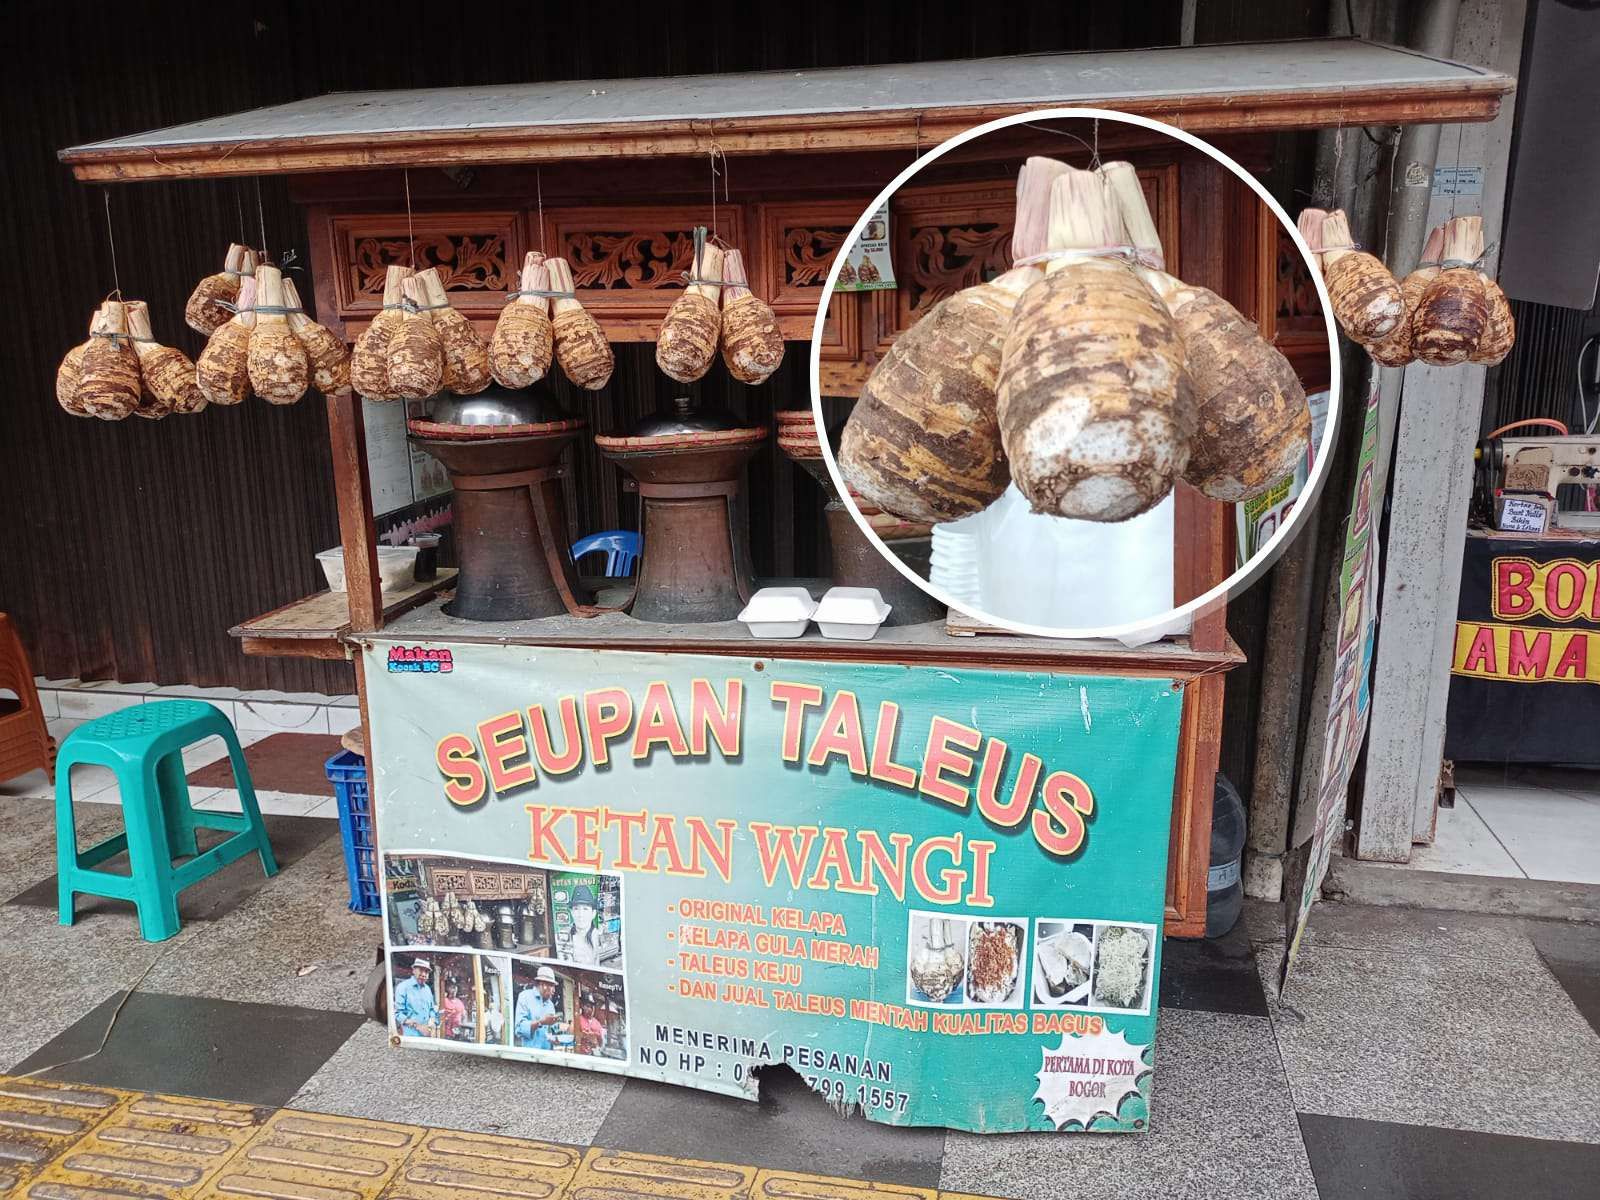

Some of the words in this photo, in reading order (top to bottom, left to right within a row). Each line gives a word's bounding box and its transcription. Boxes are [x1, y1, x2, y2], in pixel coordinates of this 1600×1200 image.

[388, 645, 453, 661] Makan
[435, 678, 744, 806] SEUPAN
[769, 680, 1095, 858] TALEUS
[524, 804, 737, 884] KETAN
[748, 822, 997, 908] WANGI
[678, 898, 767, 927] ORIGINAL
[771, 907, 847, 936] KELAPA
[678, 925, 751, 951] KELAPA
[755, 931, 807, 959] GULA
[810, 940, 879, 969] MERAH
[678, 952, 748, 978] TALEUS
[753, 959, 802, 986] KEJU
[679, 979, 717, 1001] DAN
[722, 983, 769, 1008] JUAL
[773, 990, 845, 1017] TALEUS
[850, 1000, 928, 1032] MENTAH
[932, 1011, 1028, 1035] KUALITAS
[1031, 1014, 1105, 1036] BAGUS
[655, 1024, 772, 1060] MENERIMA
[782, 1045, 892, 1082] PESANAN
[1044, 1056, 1092, 1075] PERTAMA
[1091, 1058, 1105, 1075] DI
[1106, 1058, 1136, 1076] KOTA
[640, 1047, 668, 1067] NO
[678, 1053, 706, 1073] HP
[856, 1085, 909, 1112] 1557
[1068, 1080, 1107, 1099] BOGOR
